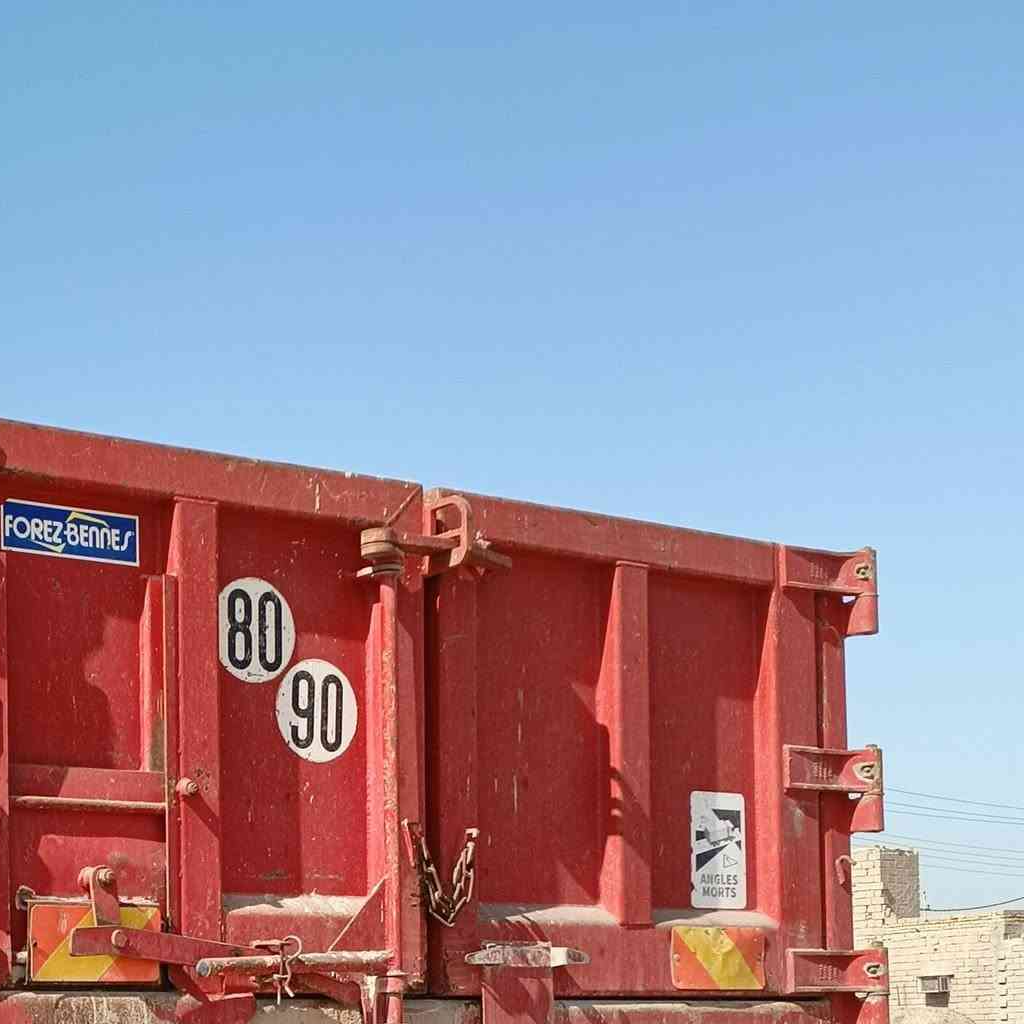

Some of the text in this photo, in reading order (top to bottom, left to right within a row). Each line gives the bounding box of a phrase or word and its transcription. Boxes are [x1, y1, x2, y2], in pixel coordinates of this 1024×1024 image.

[227, 588, 283, 673] 80
[290, 669, 344, 752] 90
[699, 873, 739, 886] ANGLES
[701, 886, 737, 898] MORTS
